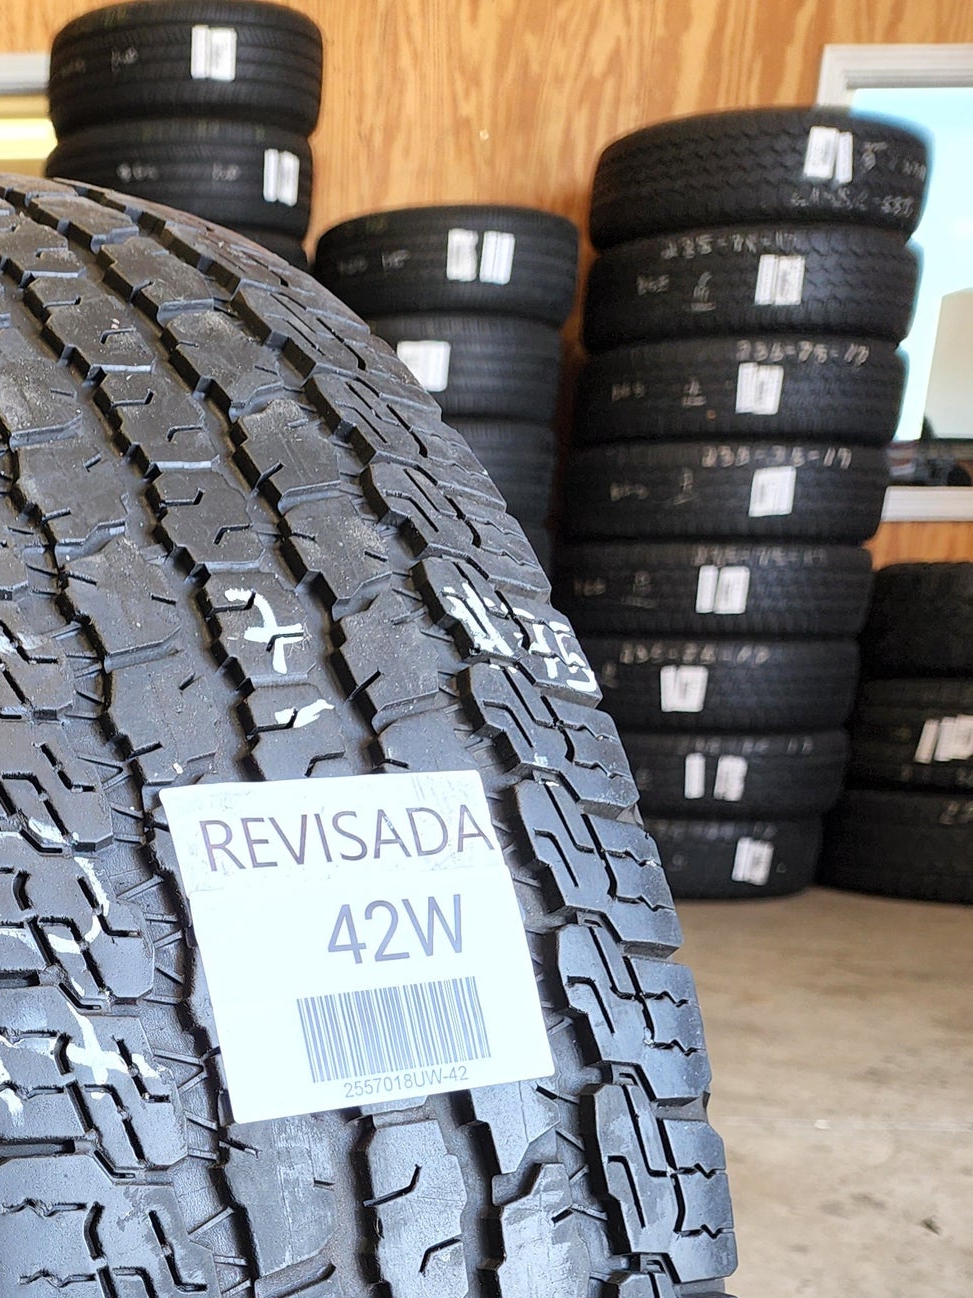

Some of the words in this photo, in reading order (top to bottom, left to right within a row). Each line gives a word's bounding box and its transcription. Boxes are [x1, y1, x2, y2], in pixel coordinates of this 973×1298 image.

[199, 804, 495, 872] REVISADA
[327, 894, 464, 964] 42W
[343, 1065, 469, 1099] 2557018UW-42
